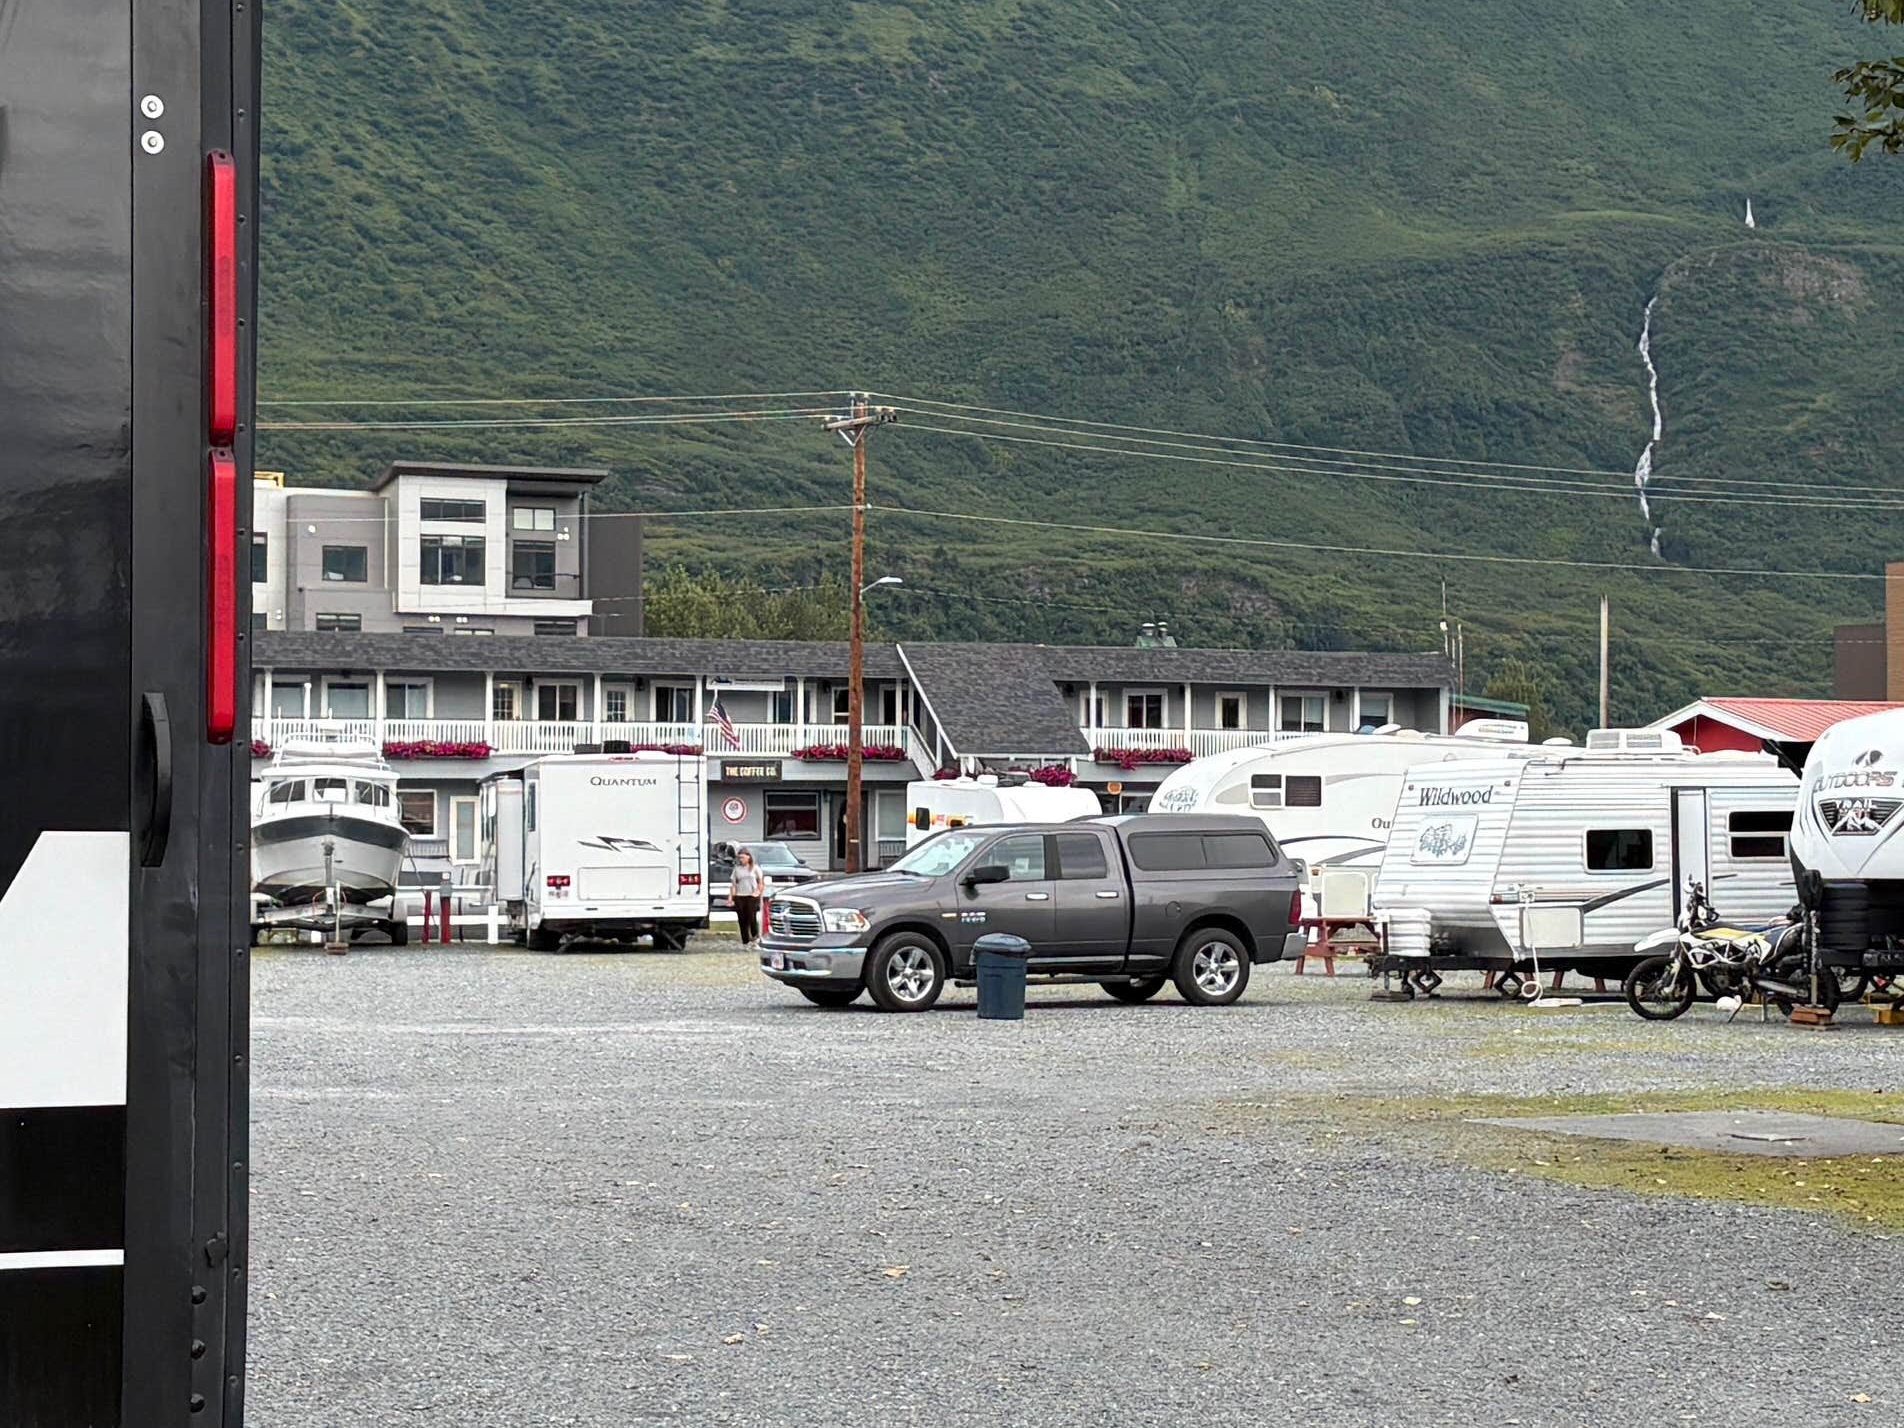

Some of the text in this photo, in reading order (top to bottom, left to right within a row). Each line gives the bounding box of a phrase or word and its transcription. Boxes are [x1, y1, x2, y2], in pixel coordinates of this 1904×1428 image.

[725, 766, 738, 777] THE
[739, 766, 764, 777] COFFEE
[1419, 786, 1493, 806] Wildwood
